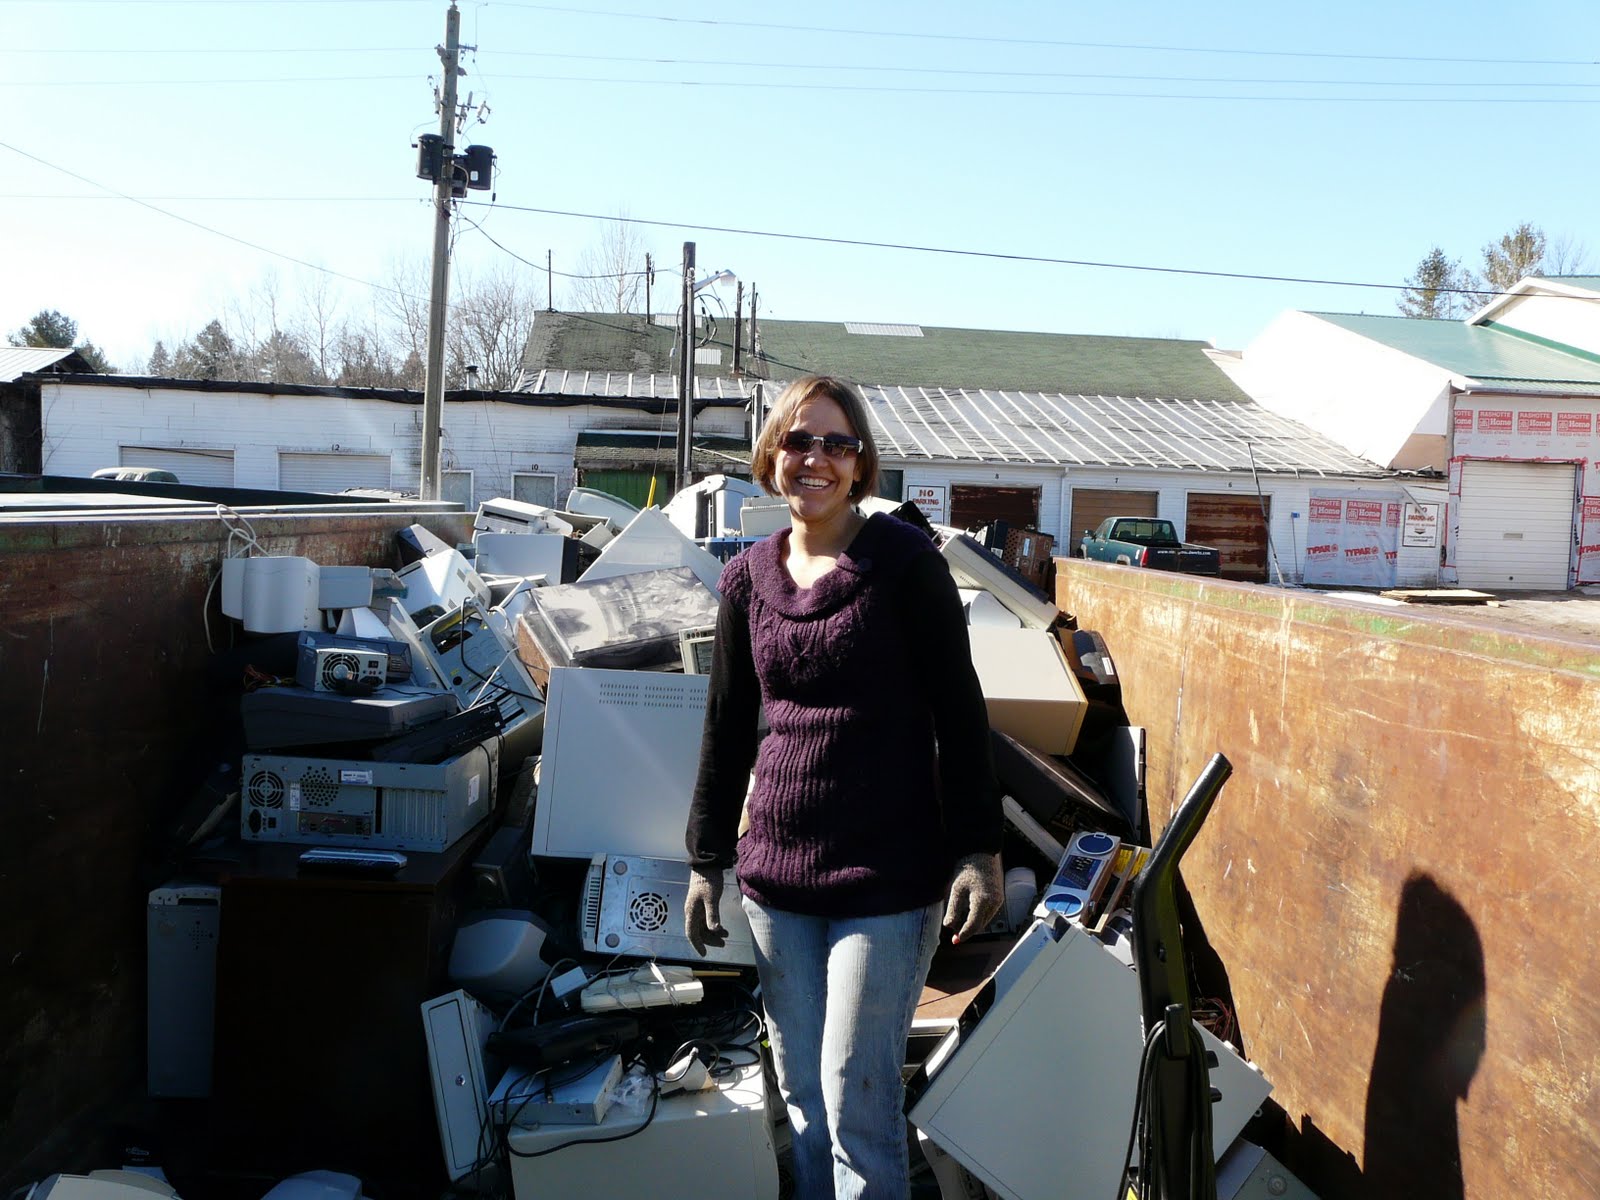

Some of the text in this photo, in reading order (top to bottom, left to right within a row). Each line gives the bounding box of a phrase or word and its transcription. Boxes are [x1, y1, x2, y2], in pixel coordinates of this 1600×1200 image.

[1490, 418, 1512, 426] Home
[1529, 419, 1551, 427] Home
[1568, 420, 1591, 428] Home
[531, 463, 539, 471] 10
[919, 489, 934, 497] NO
[1348, 501, 1381, 510] RASHOTTE
[1318, 507, 1341, 516] Home
[1359, 509, 1381, 518] Home
[1344, 547, 1371, 557] TYPAR
